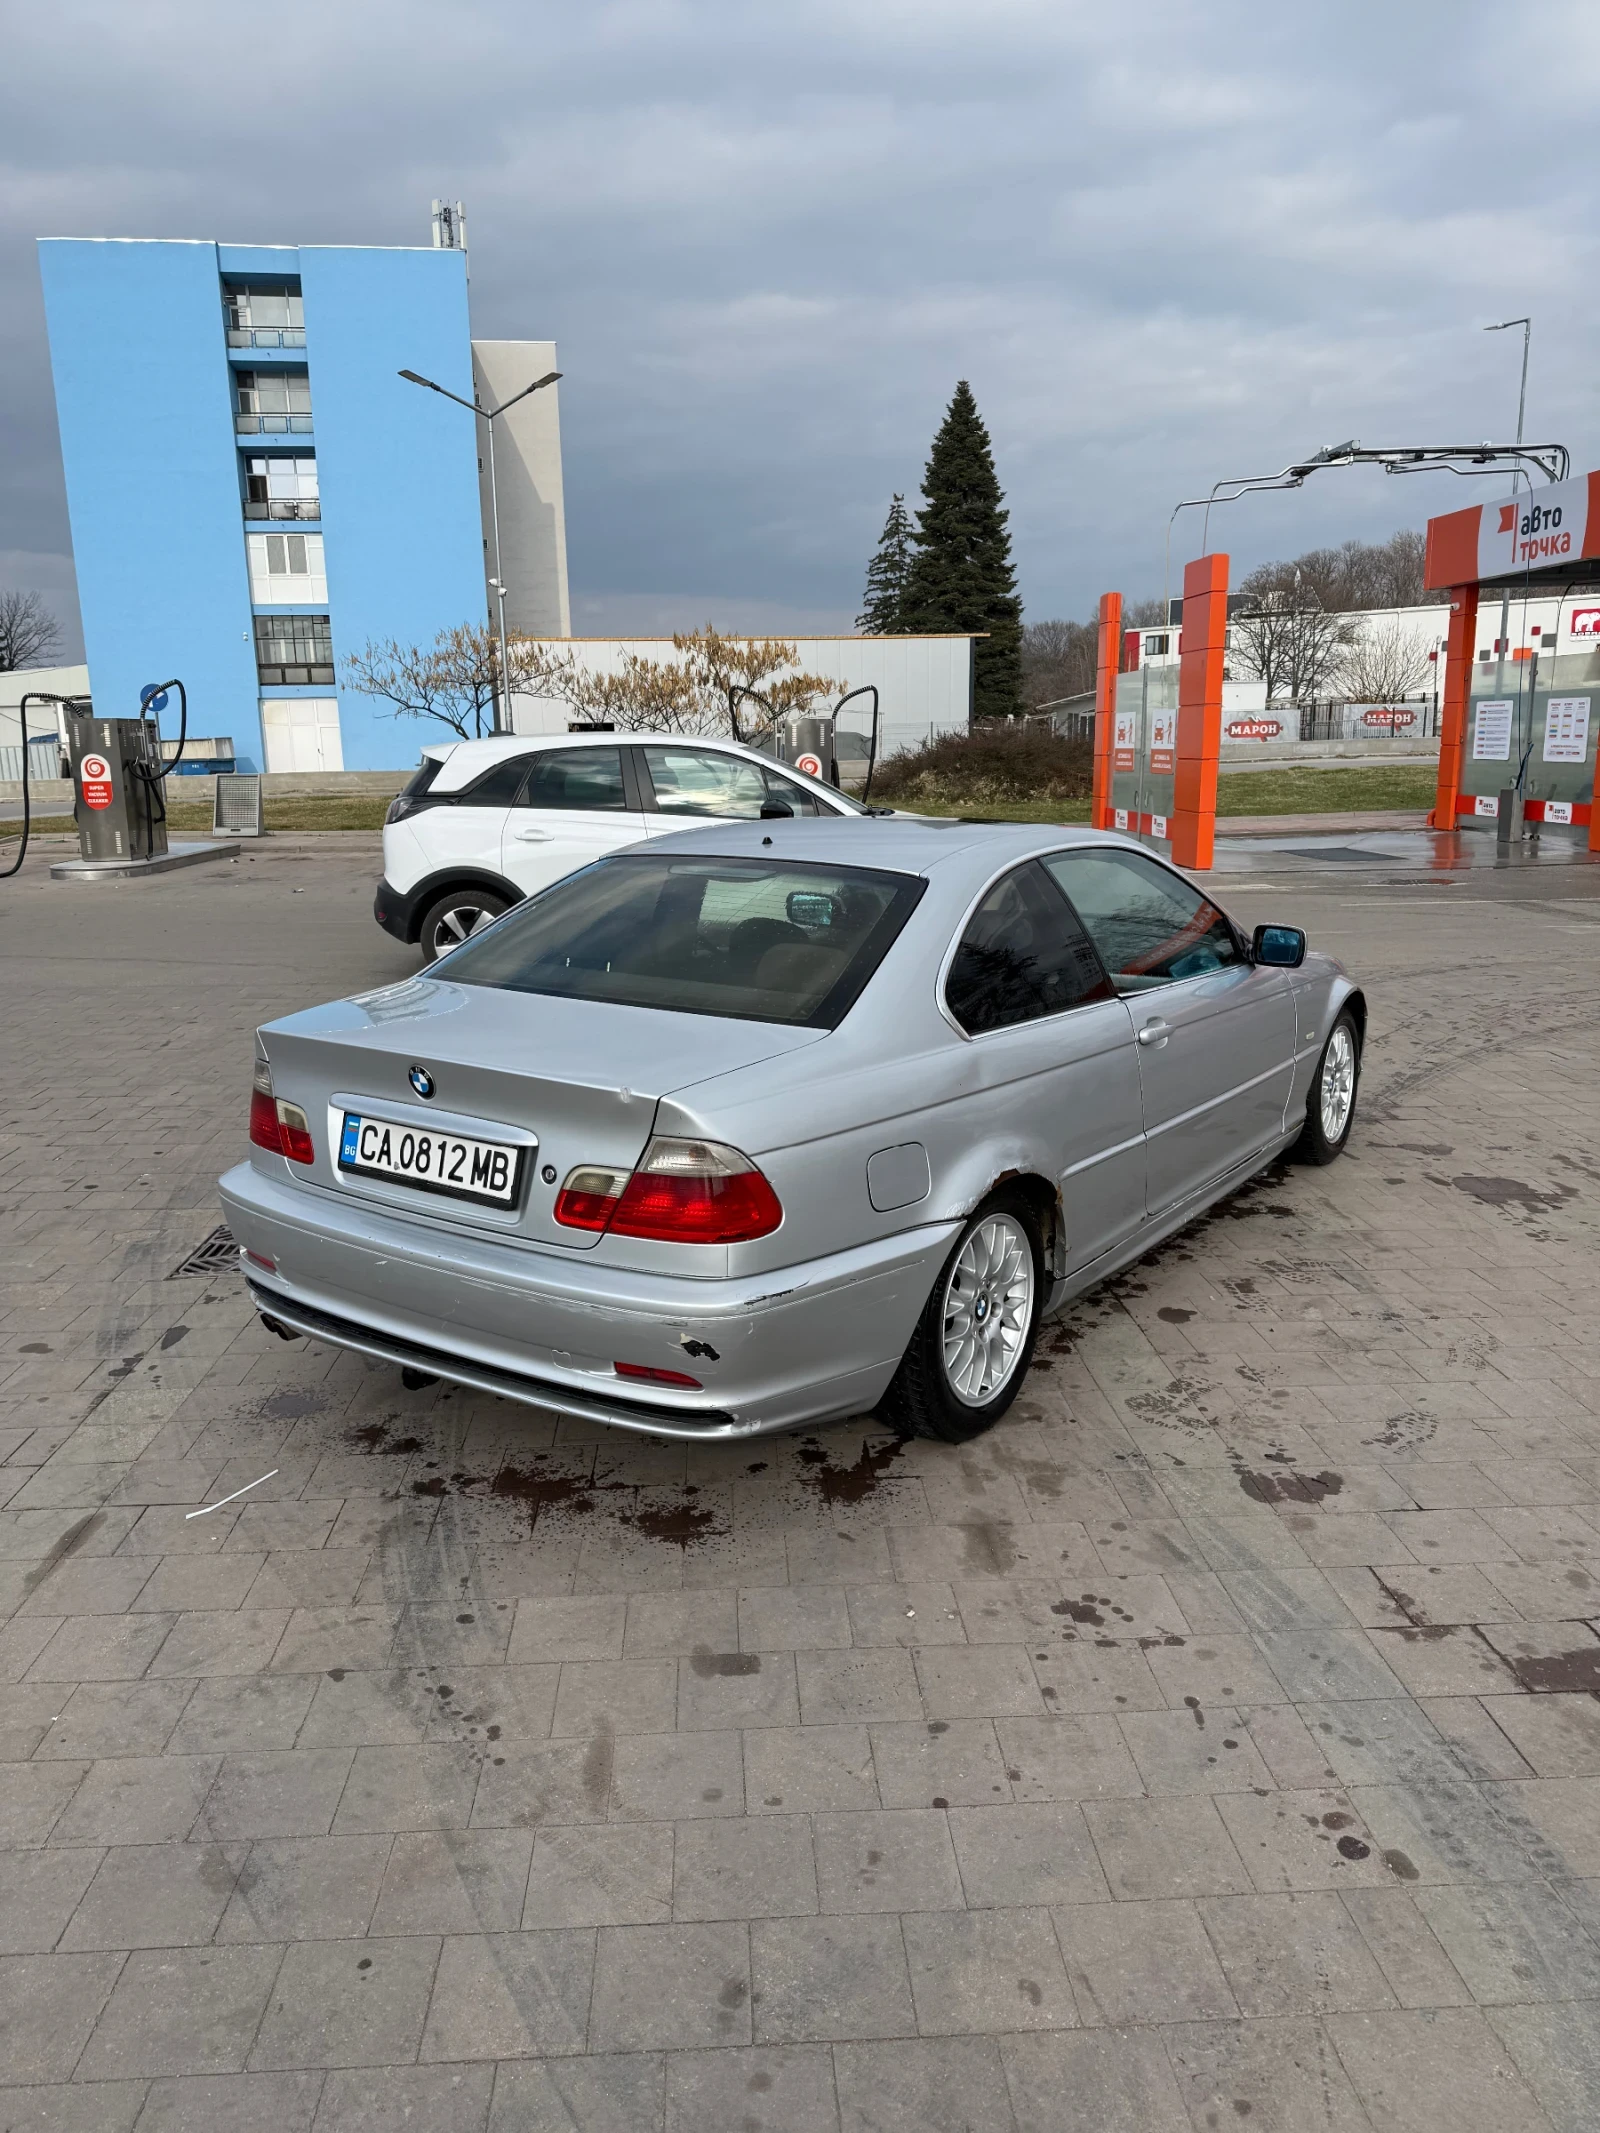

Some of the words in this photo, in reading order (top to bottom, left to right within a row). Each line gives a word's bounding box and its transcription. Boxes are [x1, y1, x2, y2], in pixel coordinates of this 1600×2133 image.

[1521, 505, 1562, 535] авто
[1520, 532, 1571, 561] точка
[1230, 724, 1278, 735] МАРОН
[344, 1144, 356, 1156] BG
[360, 1124, 392, 1166] CA
[399, 1133, 467, 1183] 0812
[470, 1146, 509, 1192] MB
